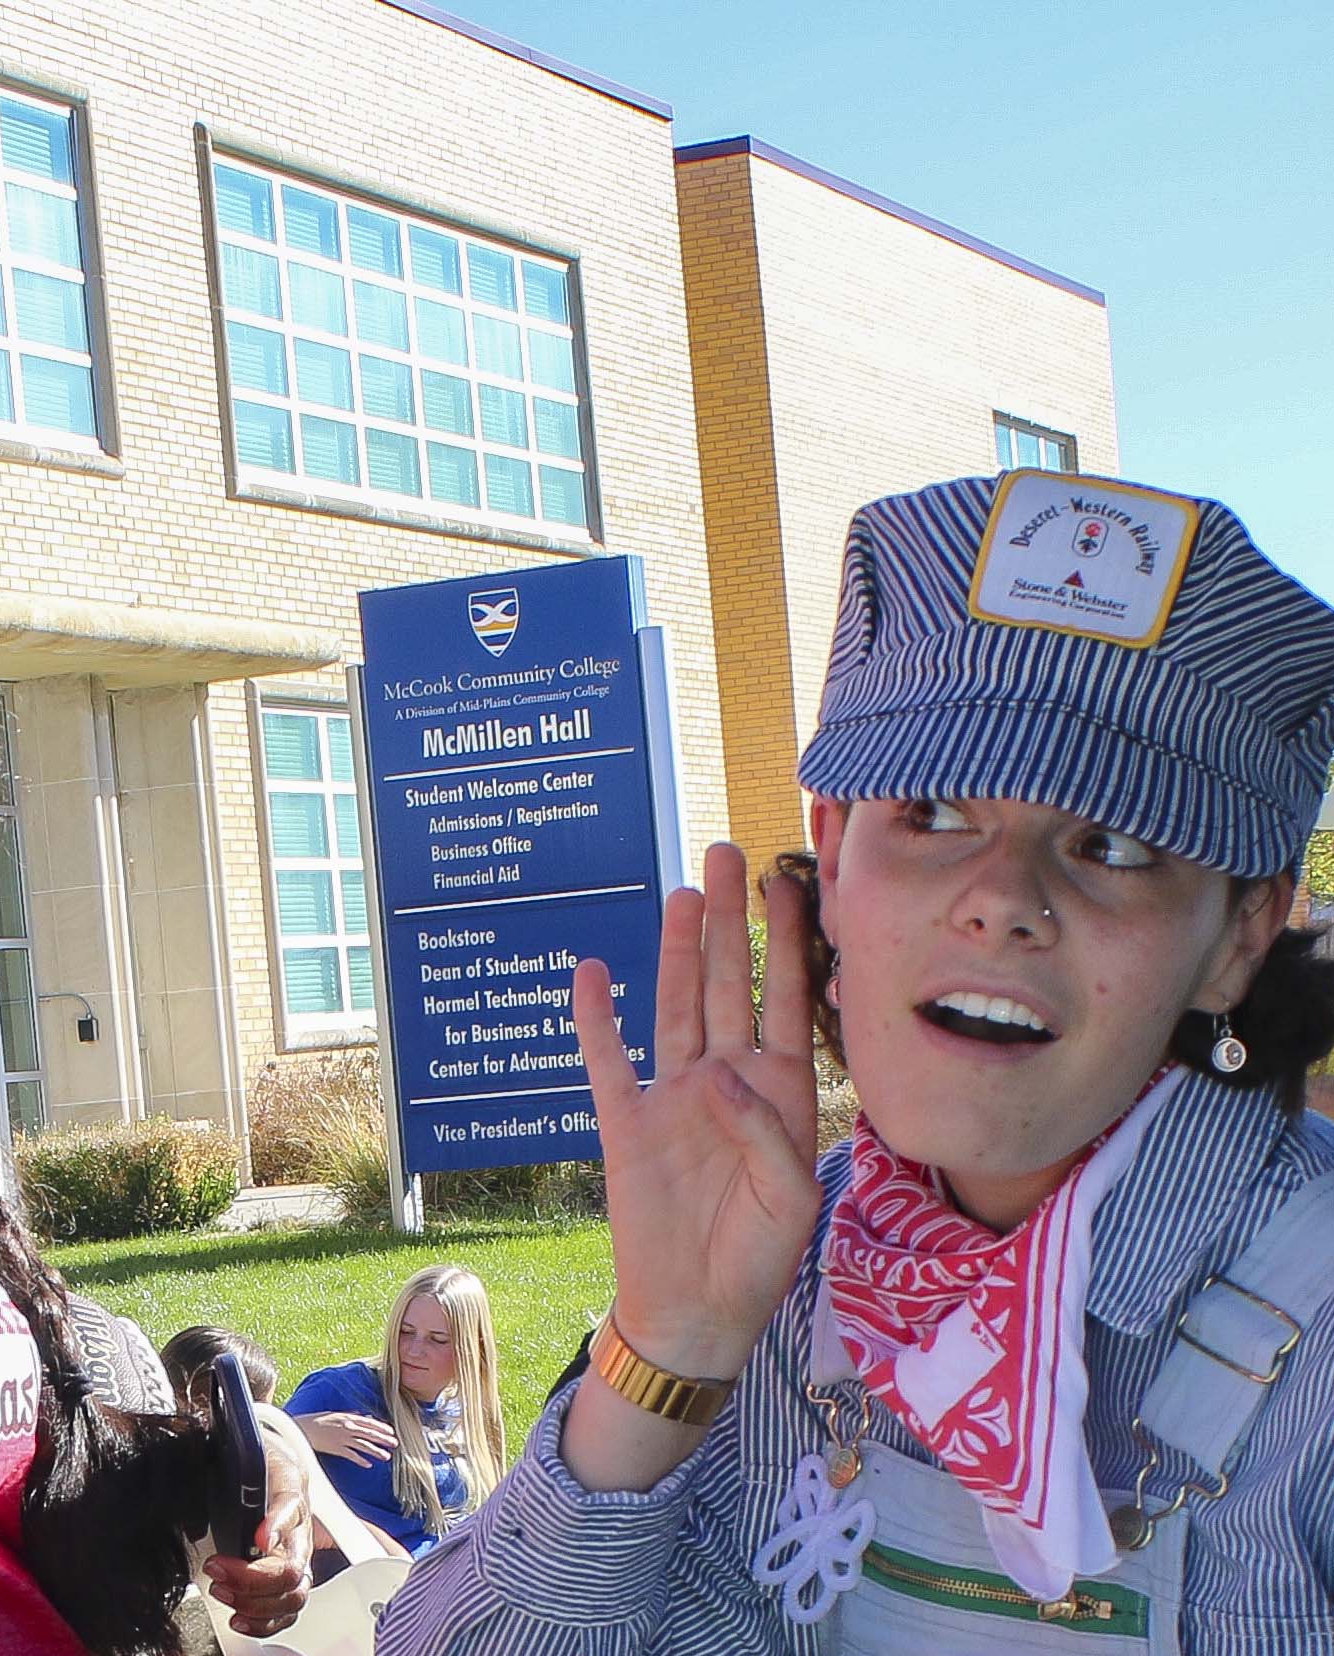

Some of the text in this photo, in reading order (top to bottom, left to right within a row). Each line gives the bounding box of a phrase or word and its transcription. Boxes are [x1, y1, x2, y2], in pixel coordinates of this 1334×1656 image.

[1013, 577, 1129, 611] Stone & Webster
[384, 656, 620, 701] McCook Community College
[395, 684, 610, 721] A Division of Mid-Plains Community College
[423, 708, 591, 758] McMillen Hall
[405, 772, 594, 808] Student Welcome Center
[429, 802, 598, 834] Admissions / Registration
[431, 837, 532, 861] Business Office
[433, 865, 520, 889] Financial Aid
[418, 929, 496, 950] Bookstore
[421, 949, 578, 982] Dean of Student Life
[424, 985, 570, 1015] Hormel Technology
[445, 1025, 467, 1045] for
[471, 1021, 538, 1042] Business
[543, 1018, 555, 1036] &
[429, 1048, 583, 1079] Center for Advanced
[434, 1110, 600, 1142] Vice President's Offic
[69, 1303, 120, 1403] Wilson
